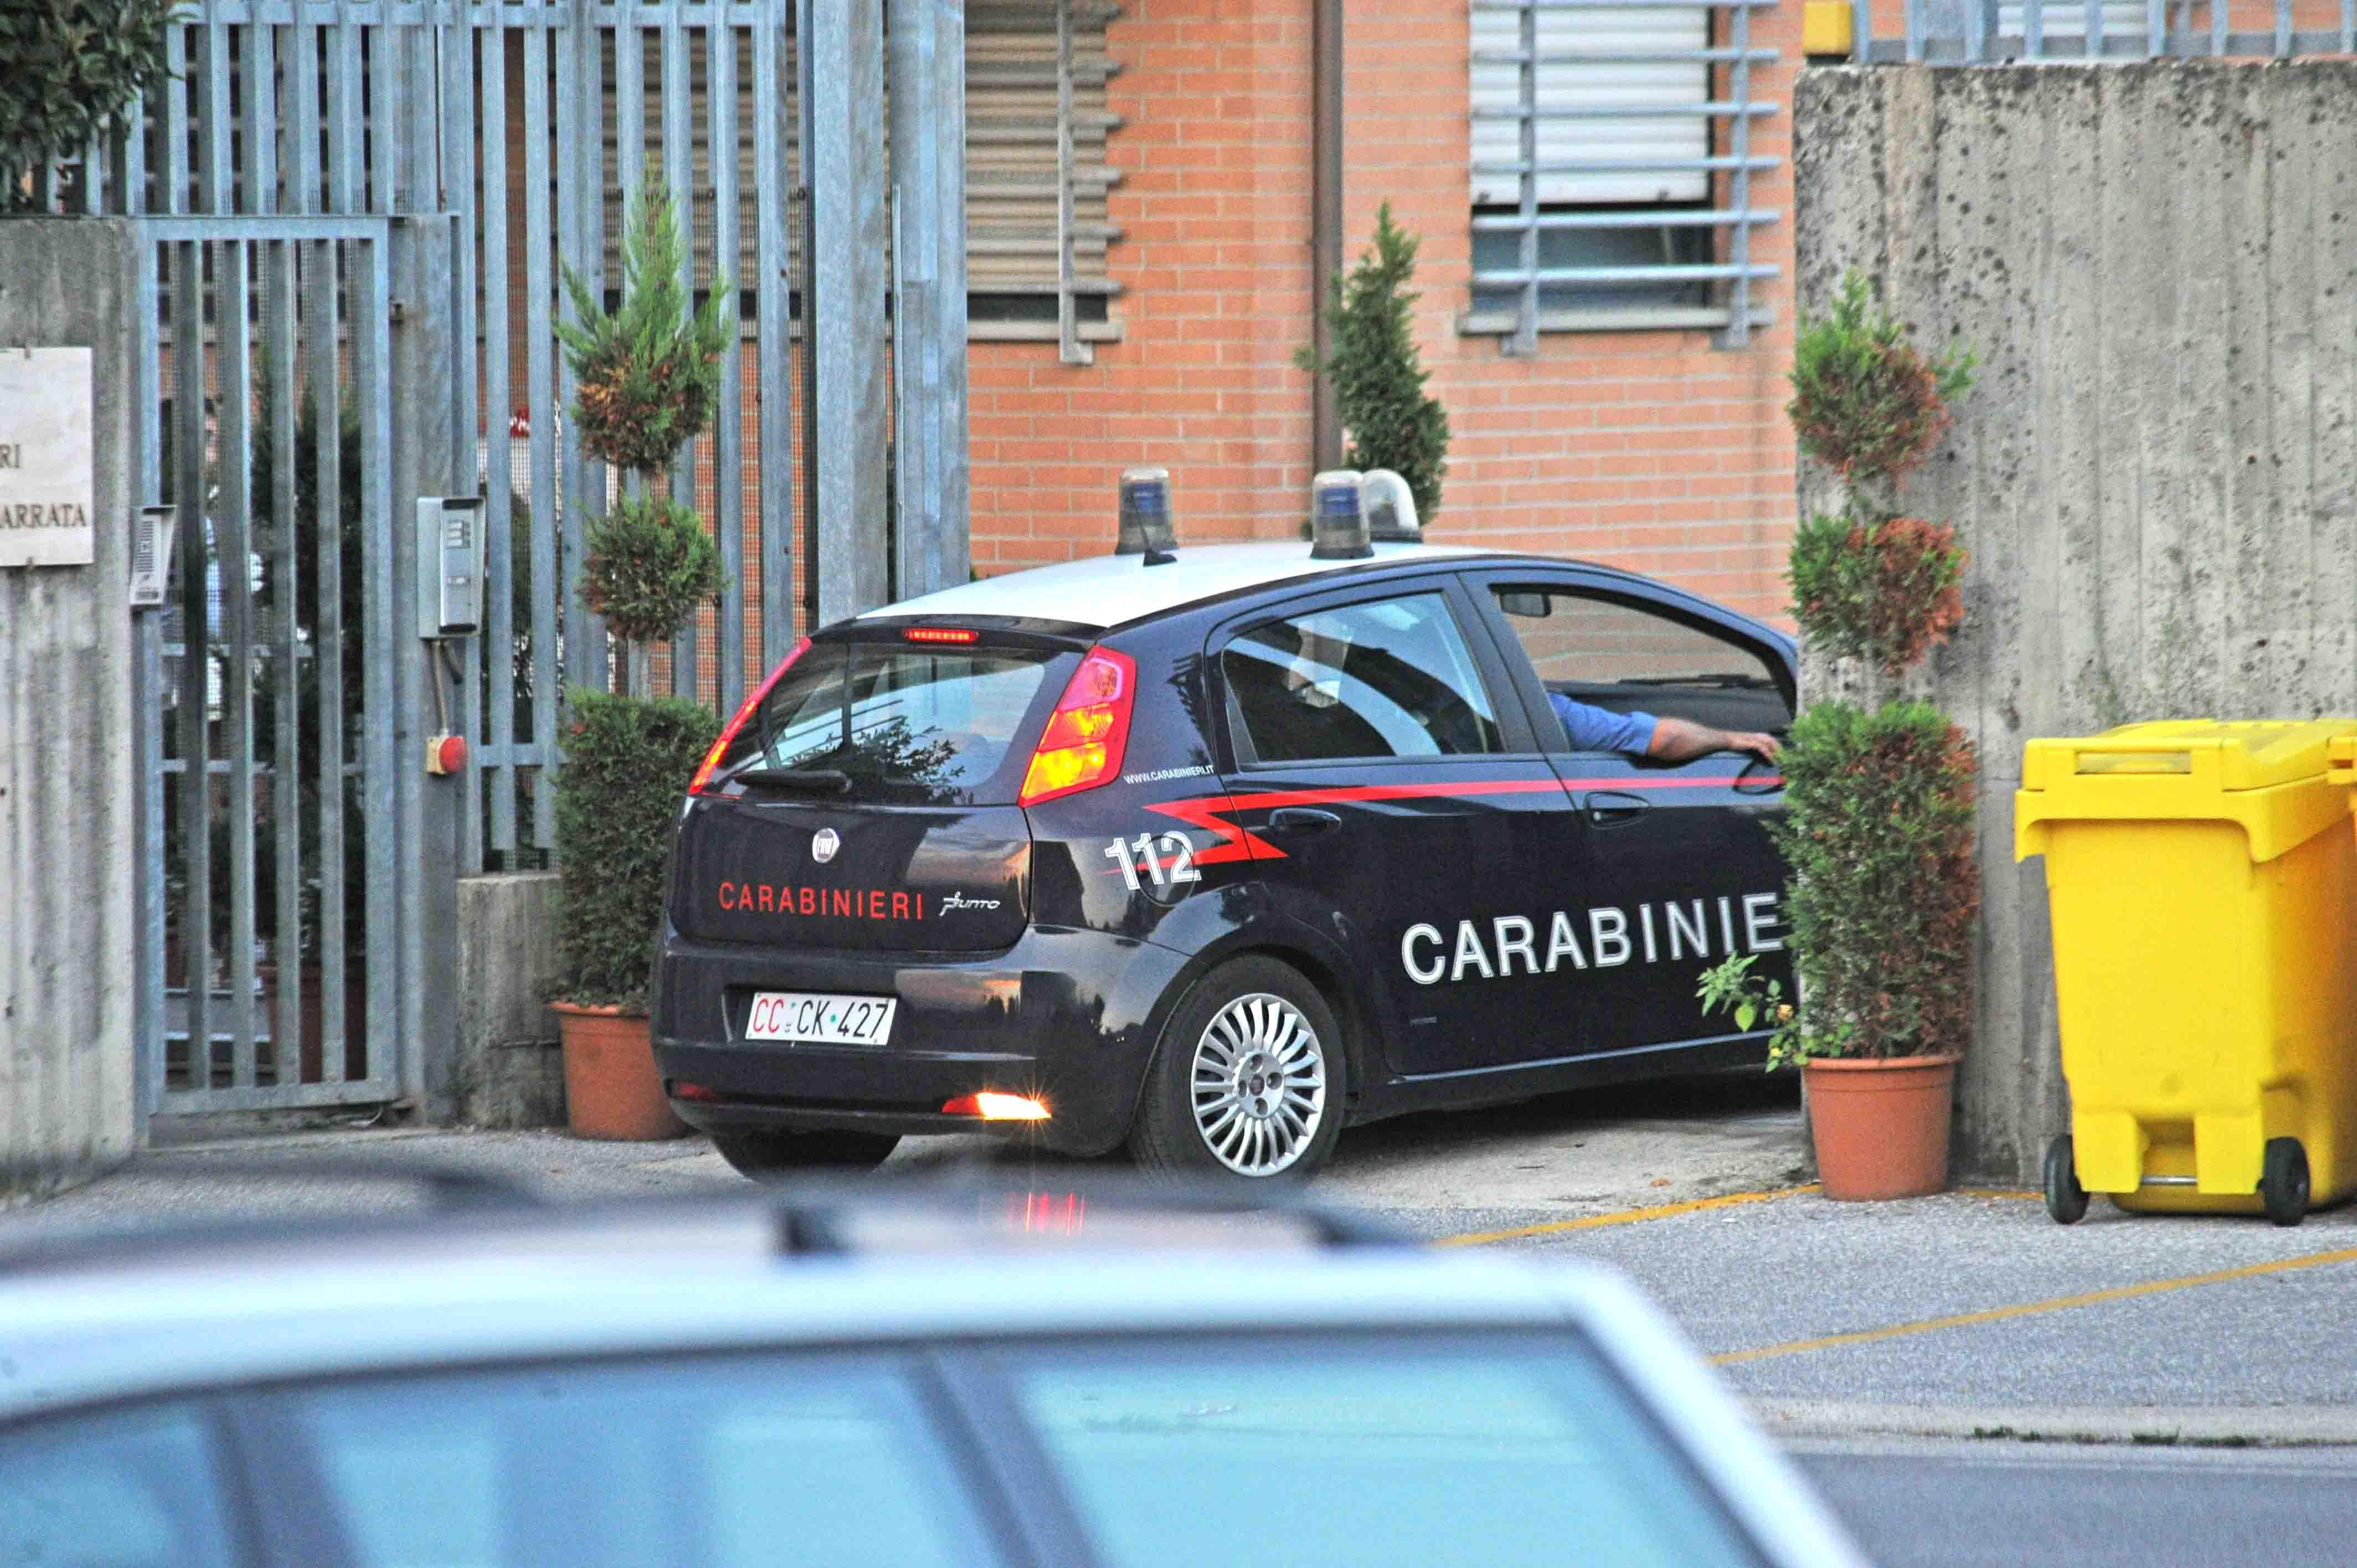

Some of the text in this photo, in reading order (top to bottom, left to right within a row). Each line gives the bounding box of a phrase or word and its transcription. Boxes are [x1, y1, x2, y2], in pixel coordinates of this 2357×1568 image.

[1123, 765, 1214, 784] WWW.CARABINIERI.IT
[1104, 831, 1202, 890] 112
[719, 881, 923, 920] CARABINIERI
[753, 998, 889, 1038] CC CK 427
